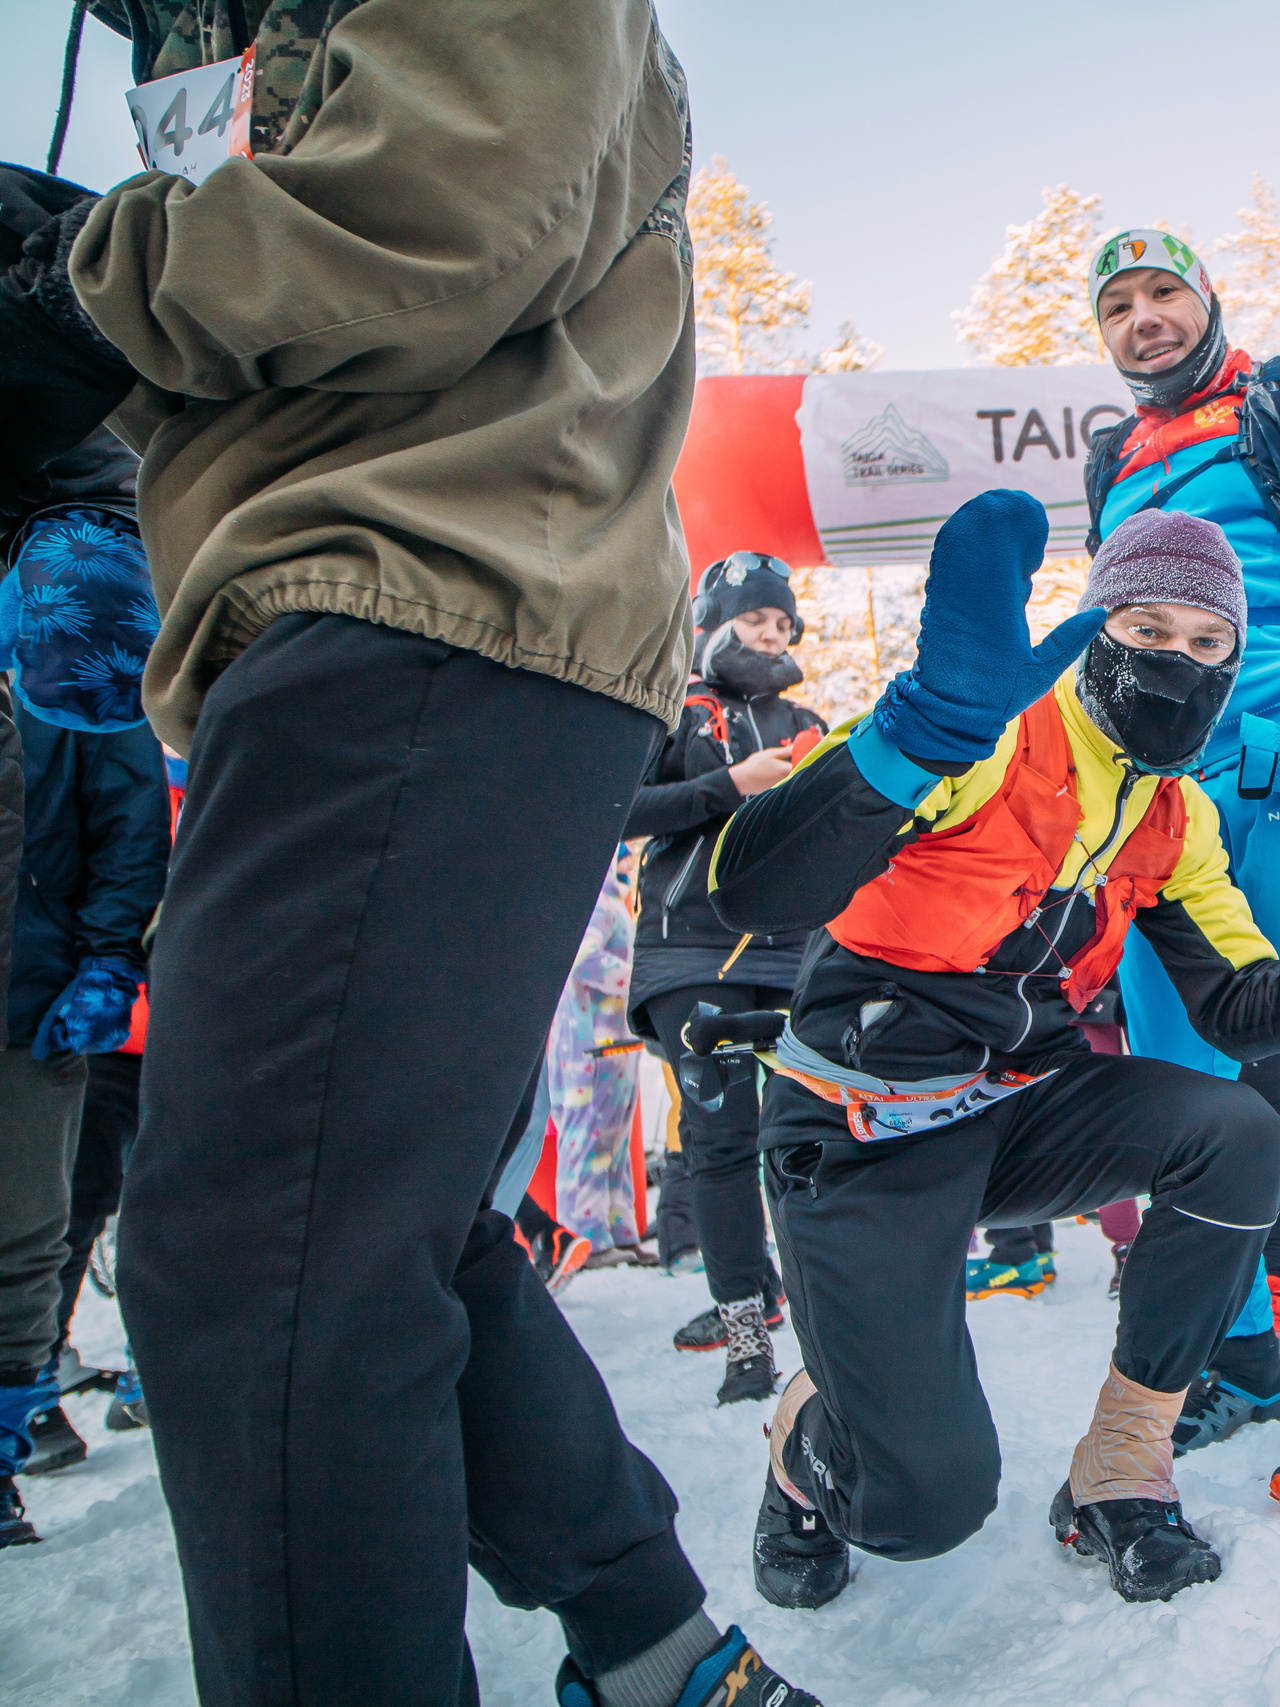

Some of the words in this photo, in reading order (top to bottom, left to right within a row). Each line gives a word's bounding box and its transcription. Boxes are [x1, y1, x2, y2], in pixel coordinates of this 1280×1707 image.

[851, 452, 885, 463] TAIGA
[853, 465, 883, 479] TRAIL
[887, 464, 924, 477] SERIES
[859, 1092, 884, 1102] ALTAI
